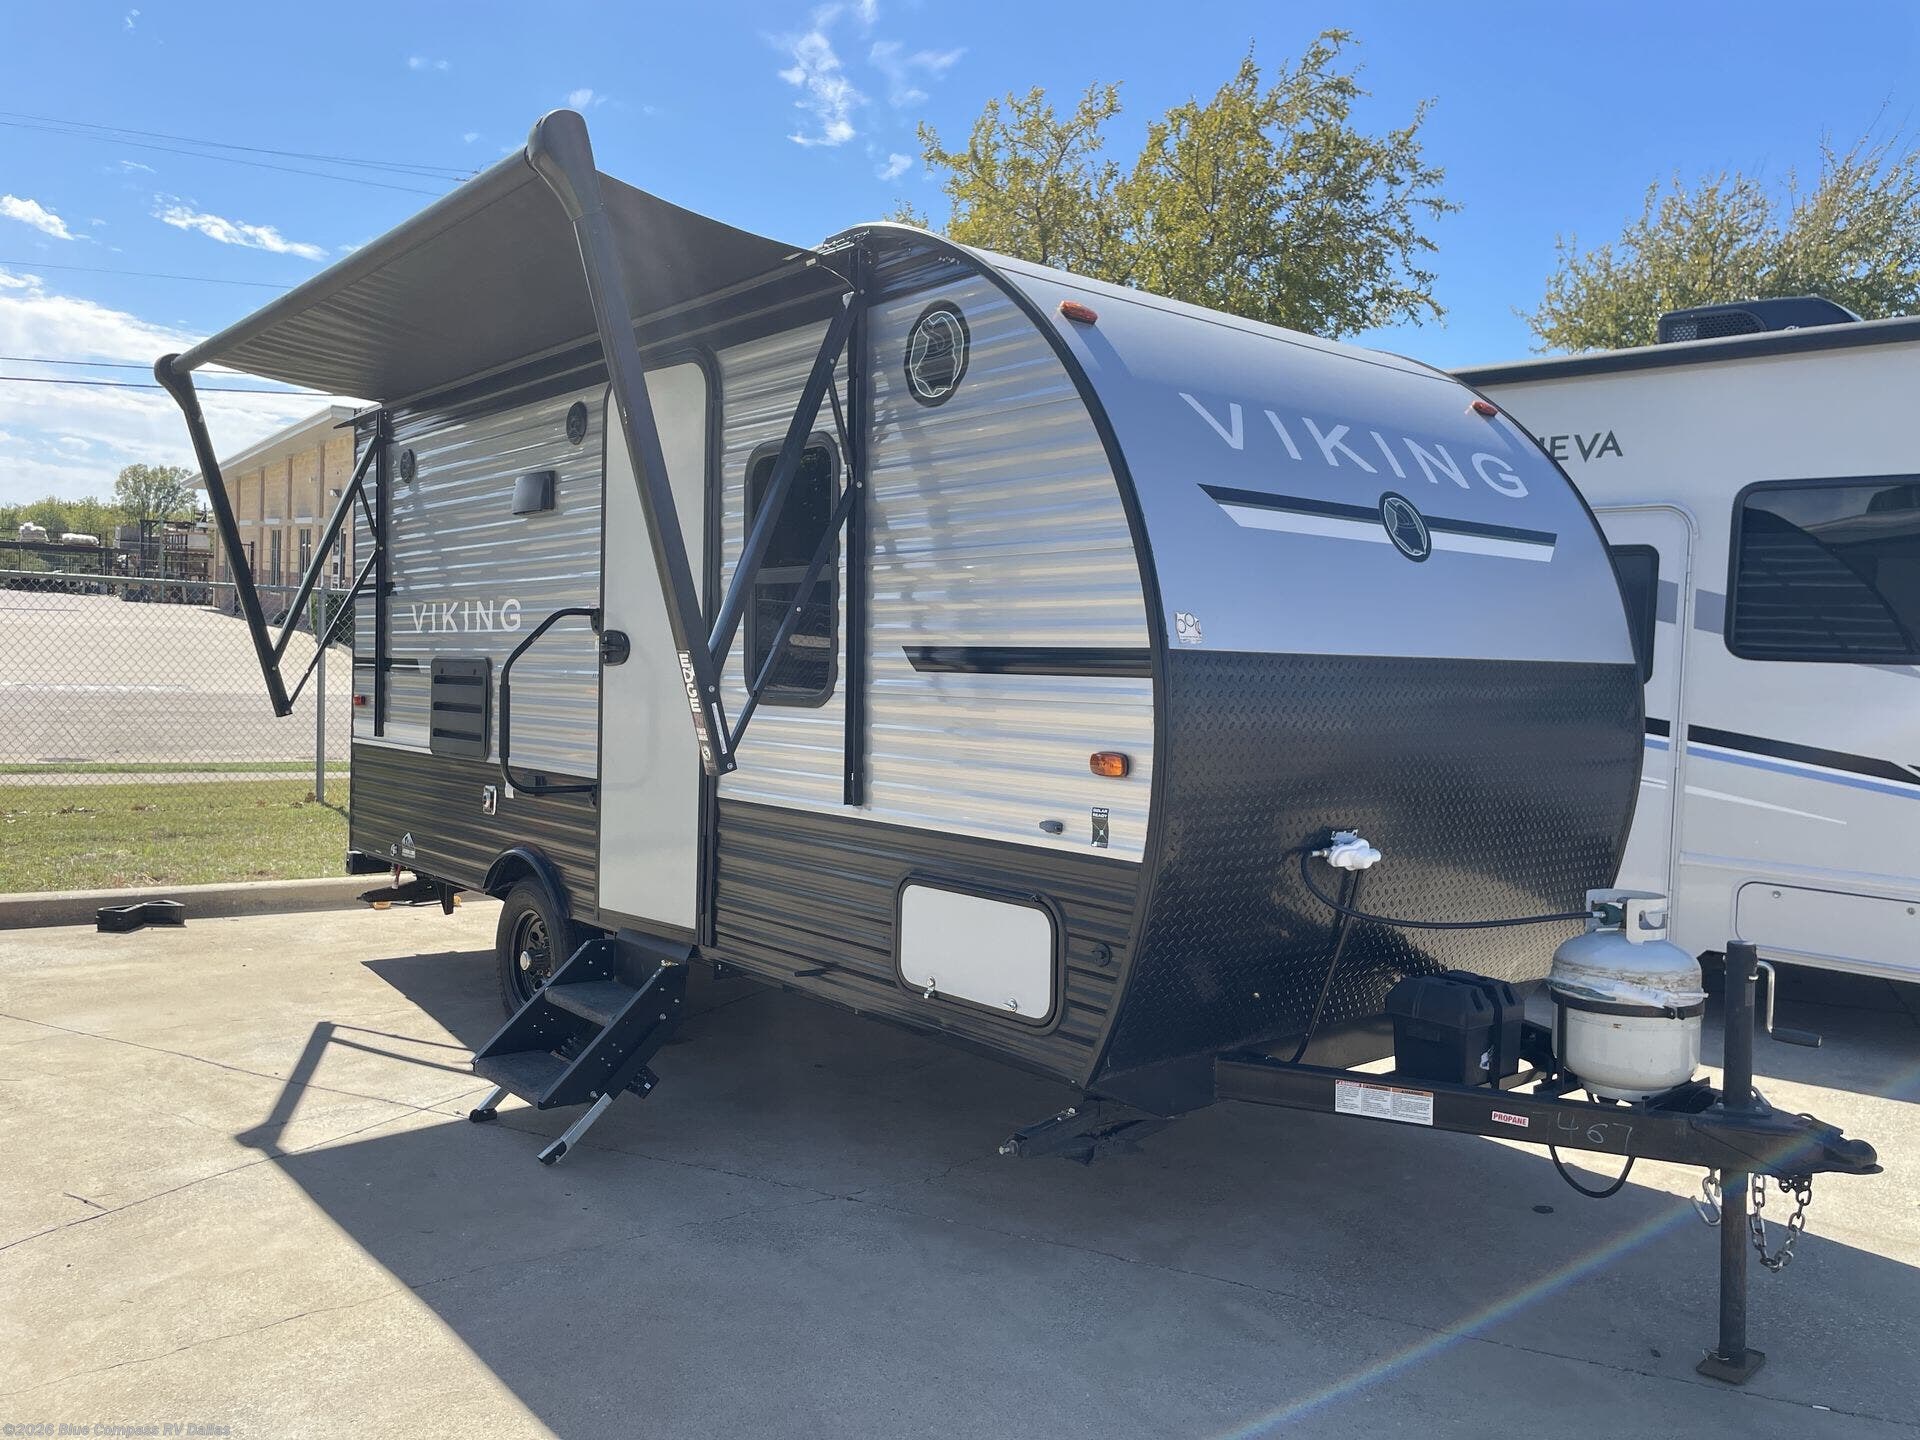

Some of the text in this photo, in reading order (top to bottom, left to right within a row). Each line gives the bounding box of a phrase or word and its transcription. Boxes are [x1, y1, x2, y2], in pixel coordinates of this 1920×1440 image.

[1178, 392, 1529, 498] VIKING
[411, 598, 521, 633] VIKING
[678, 653, 702, 713] EDGE
[1493, 1112, 1528, 1126] PROPANE
